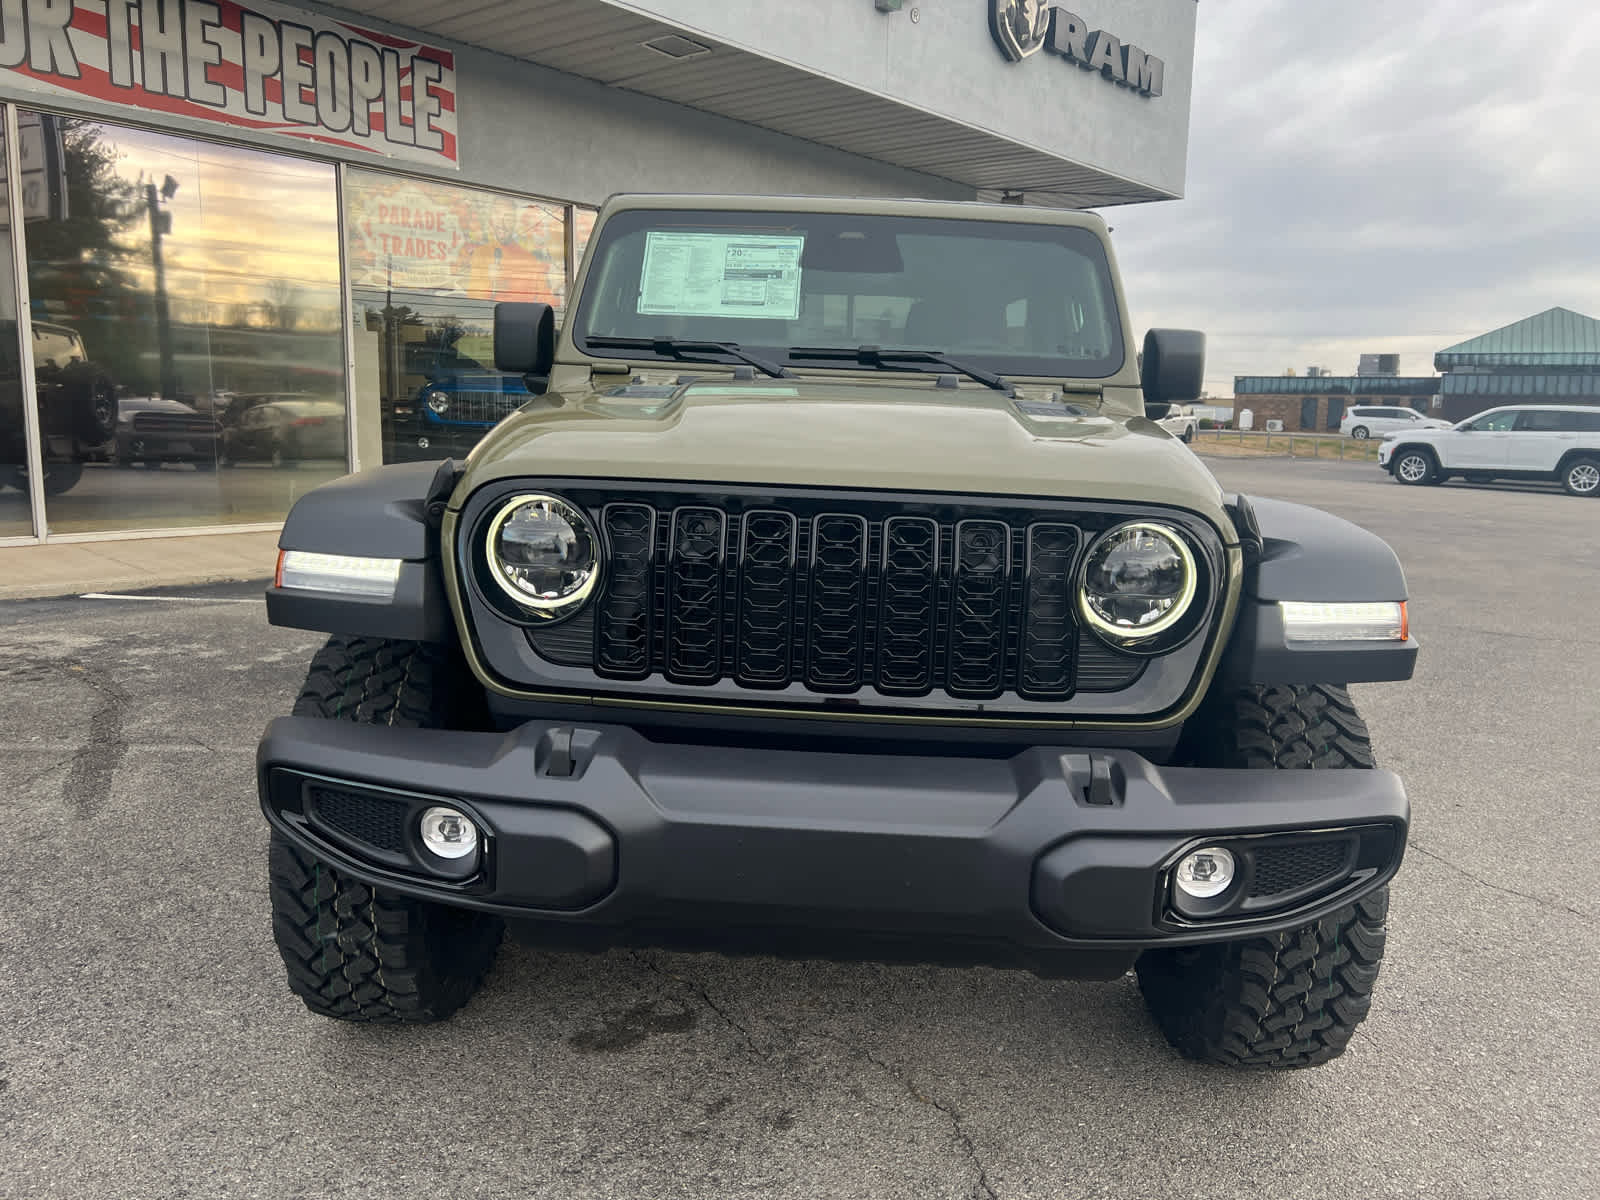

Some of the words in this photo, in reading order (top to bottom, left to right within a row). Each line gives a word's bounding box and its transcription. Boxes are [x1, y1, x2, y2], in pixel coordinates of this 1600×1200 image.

[1043, 6, 1165, 98] RAM
[105, 0, 228, 108] THE
[240, 9, 446, 152] PEOPLE
[378, 203, 447, 233] PARADE
[377, 233, 448, 261] TRADES
[731, 249, 742, 257] 20
